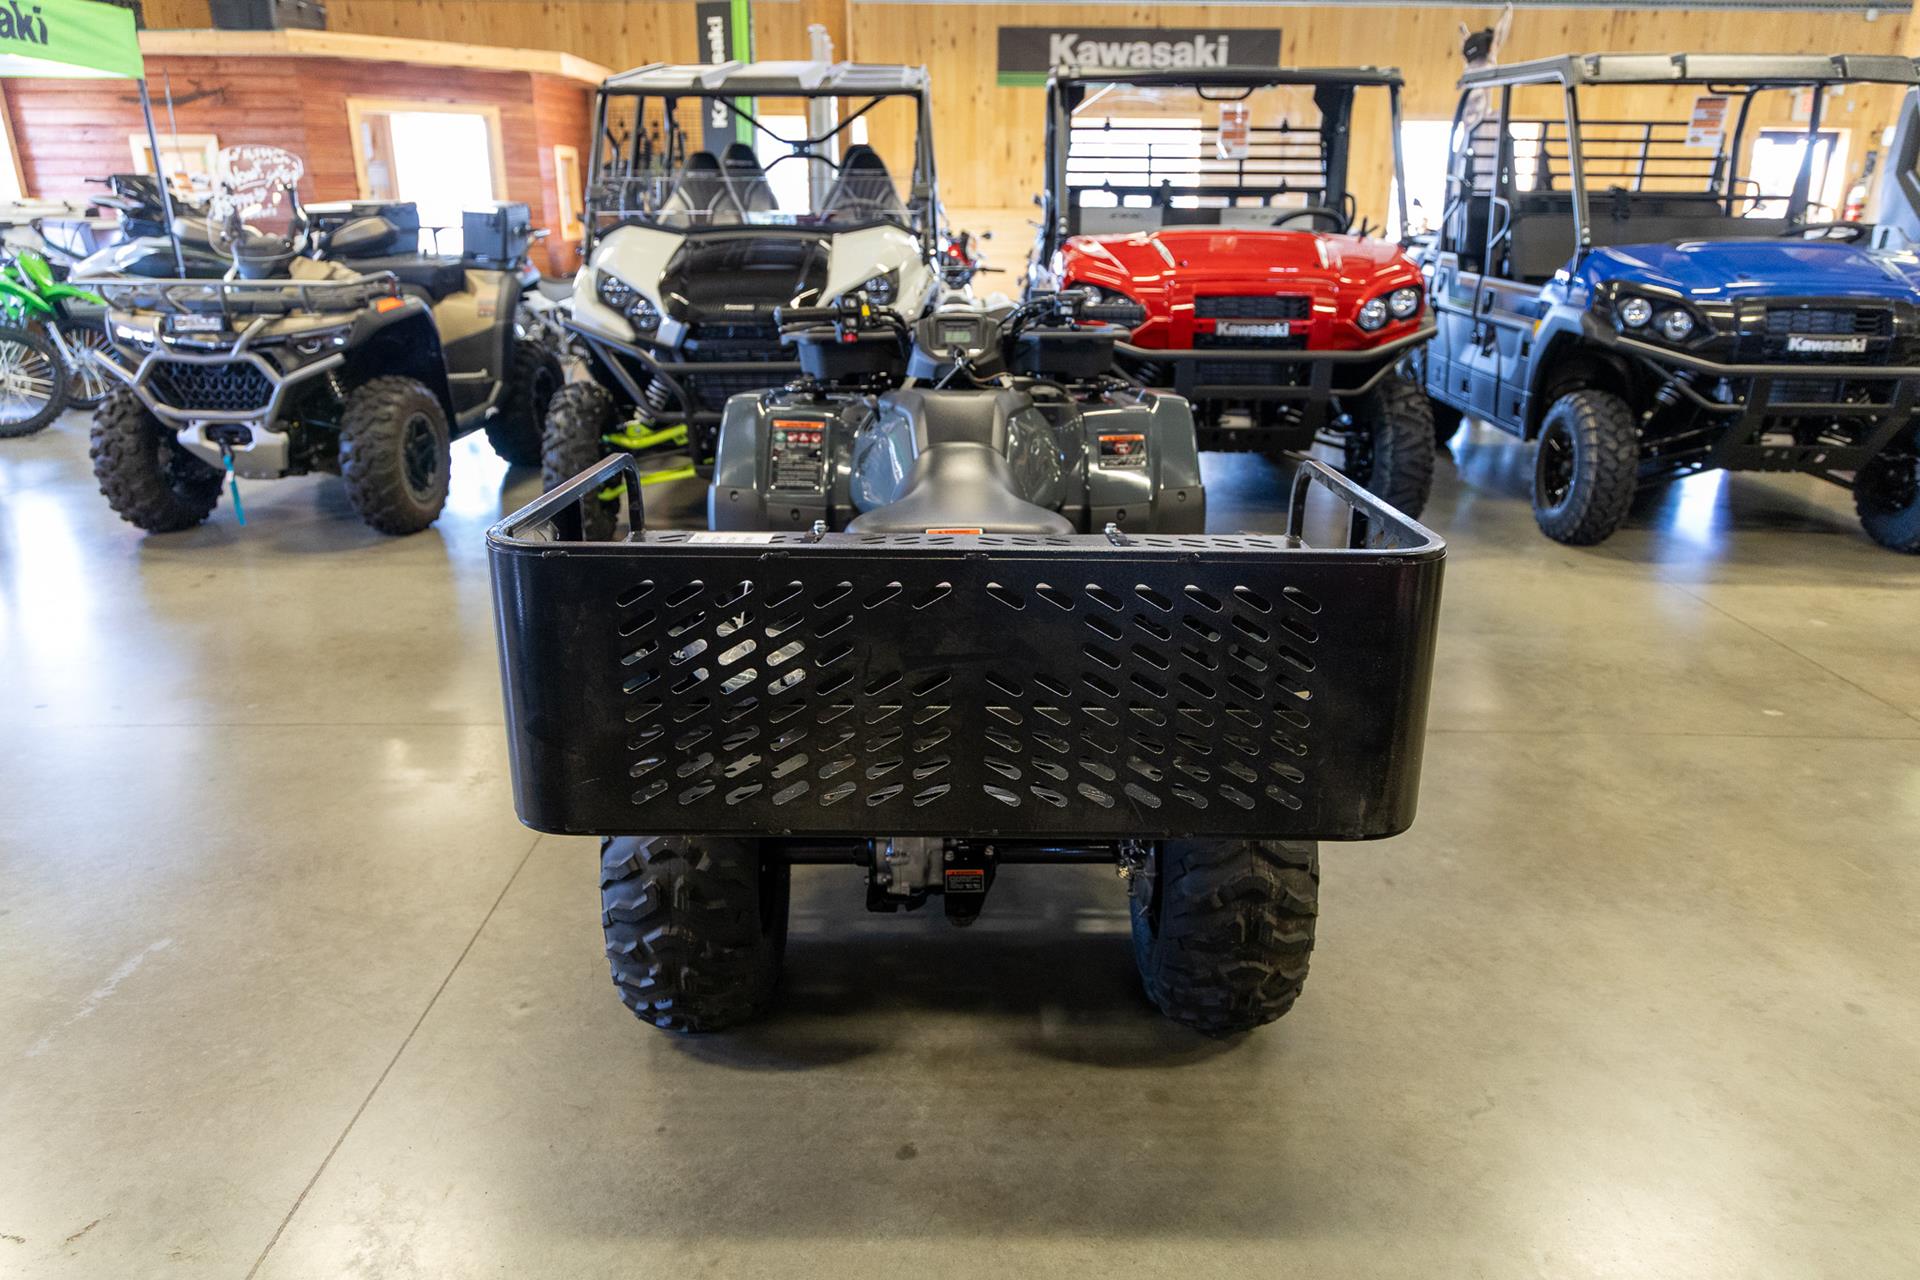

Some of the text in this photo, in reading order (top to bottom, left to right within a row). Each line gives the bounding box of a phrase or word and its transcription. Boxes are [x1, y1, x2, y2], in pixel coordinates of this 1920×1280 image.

[1050, 33, 1229, 67] Kawasaki
[1216, 321, 1290, 337] Kawasaki
[1787, 336, 1867, 352] Kawasaki
